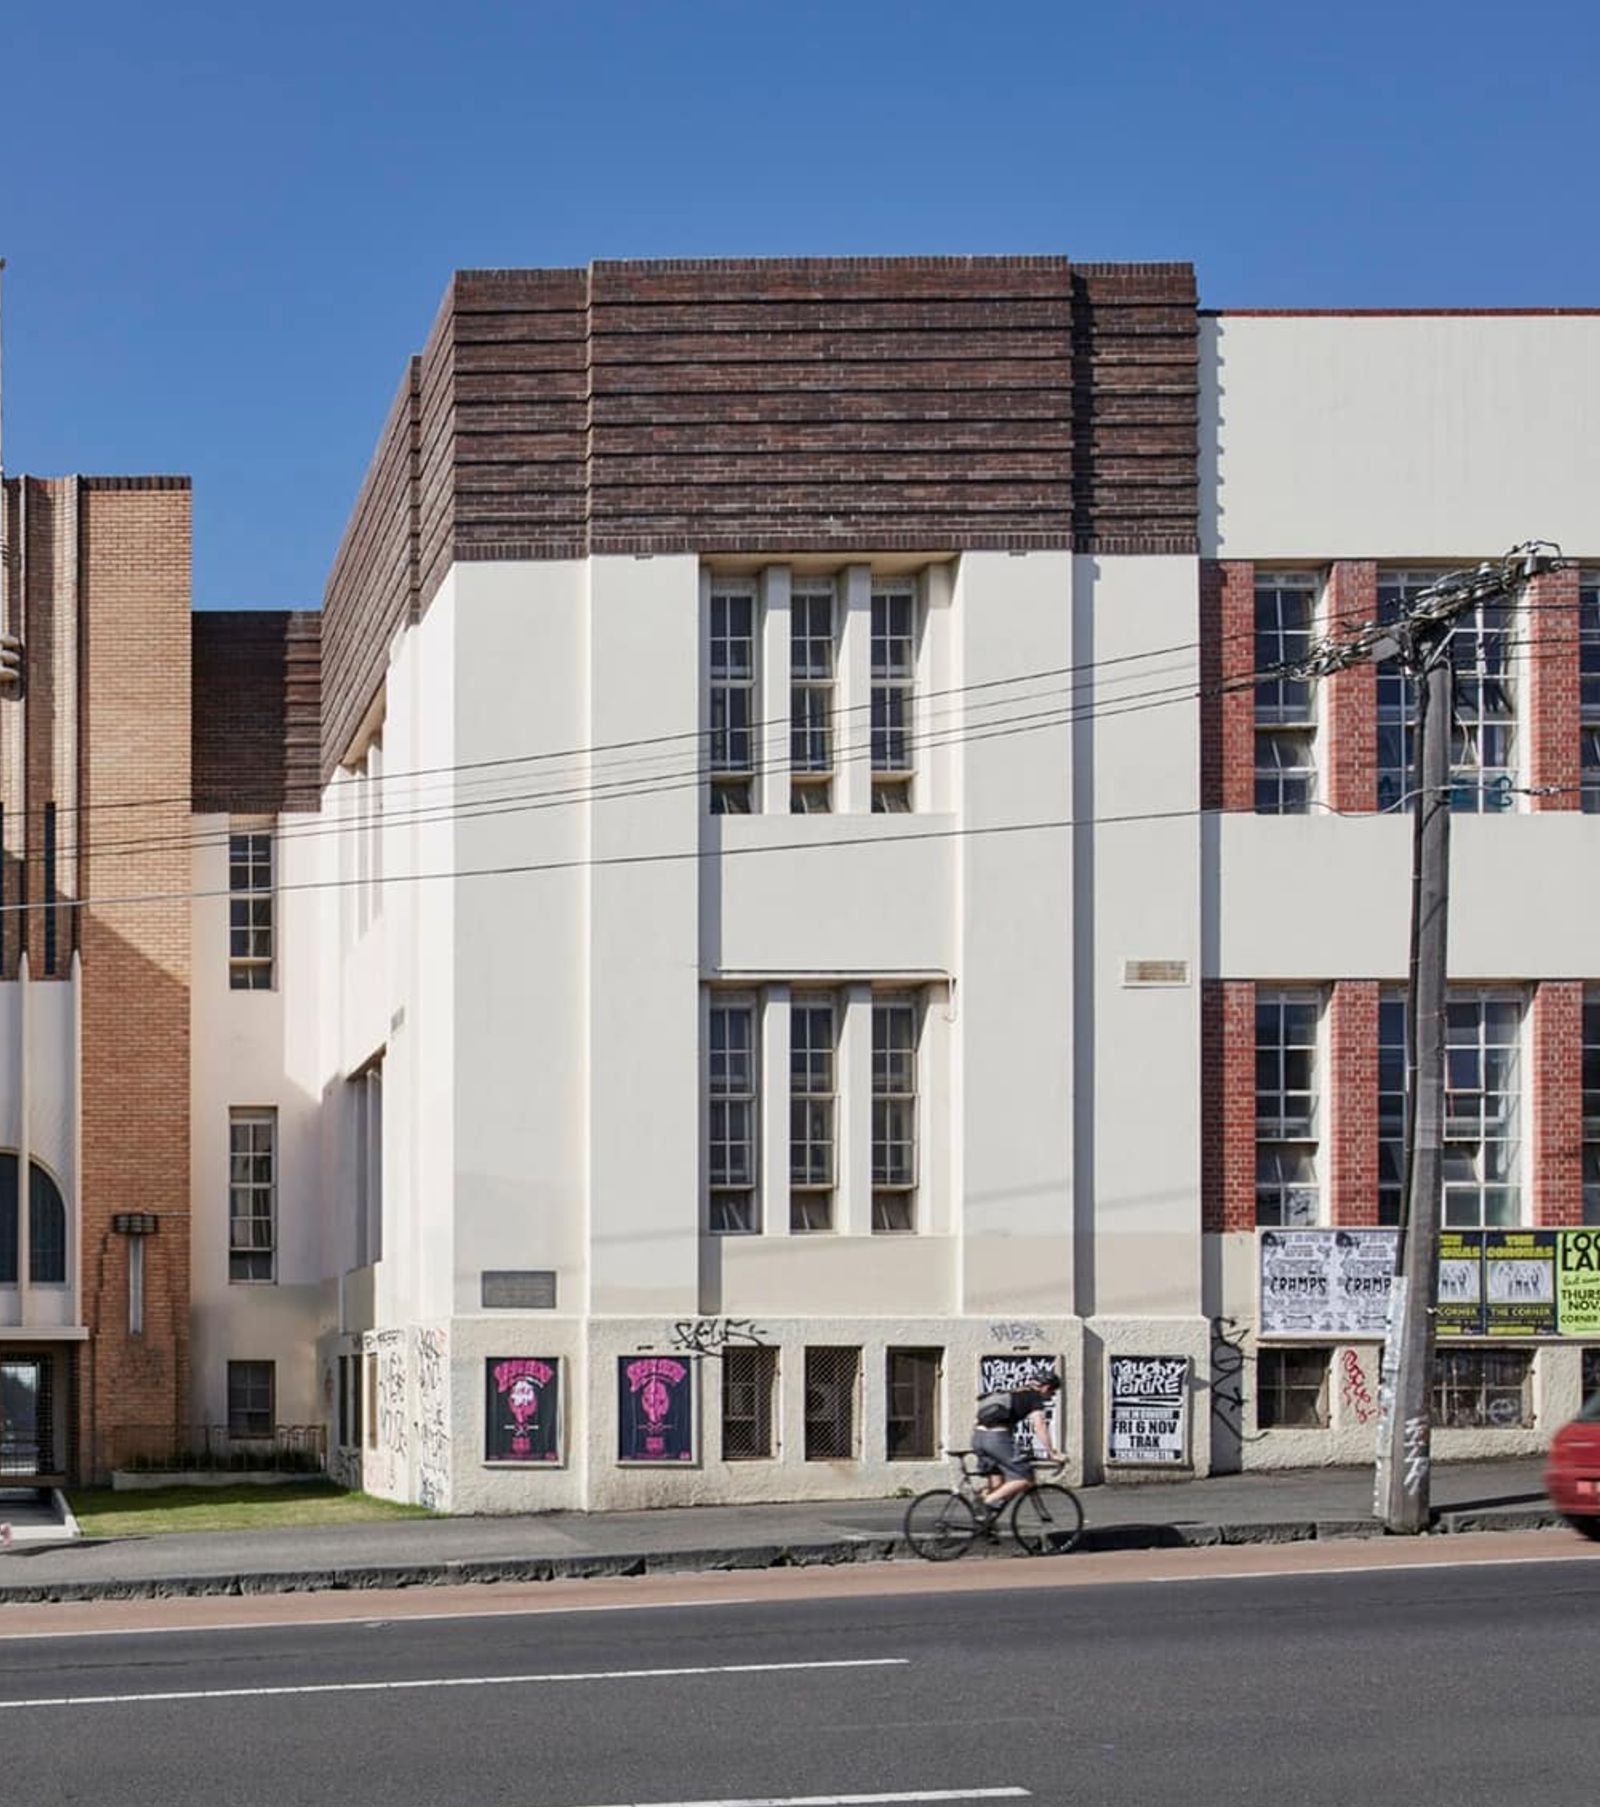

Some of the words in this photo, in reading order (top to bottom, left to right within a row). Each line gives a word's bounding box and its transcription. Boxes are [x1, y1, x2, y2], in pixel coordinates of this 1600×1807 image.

[1562, 1250, 1600, 1272] LA
[1270, 1276, 1327, 1296] CRAMPS
[1345, 1276, 1392, 1296] CRAMP
[1112, 1420, 1133, 1434] FRI
[1136, 1420, 1146, 1434] 6
[1149, 1420, 1178, 1434] NOV
[1129, 1435, 1161, 1448] TRAK
